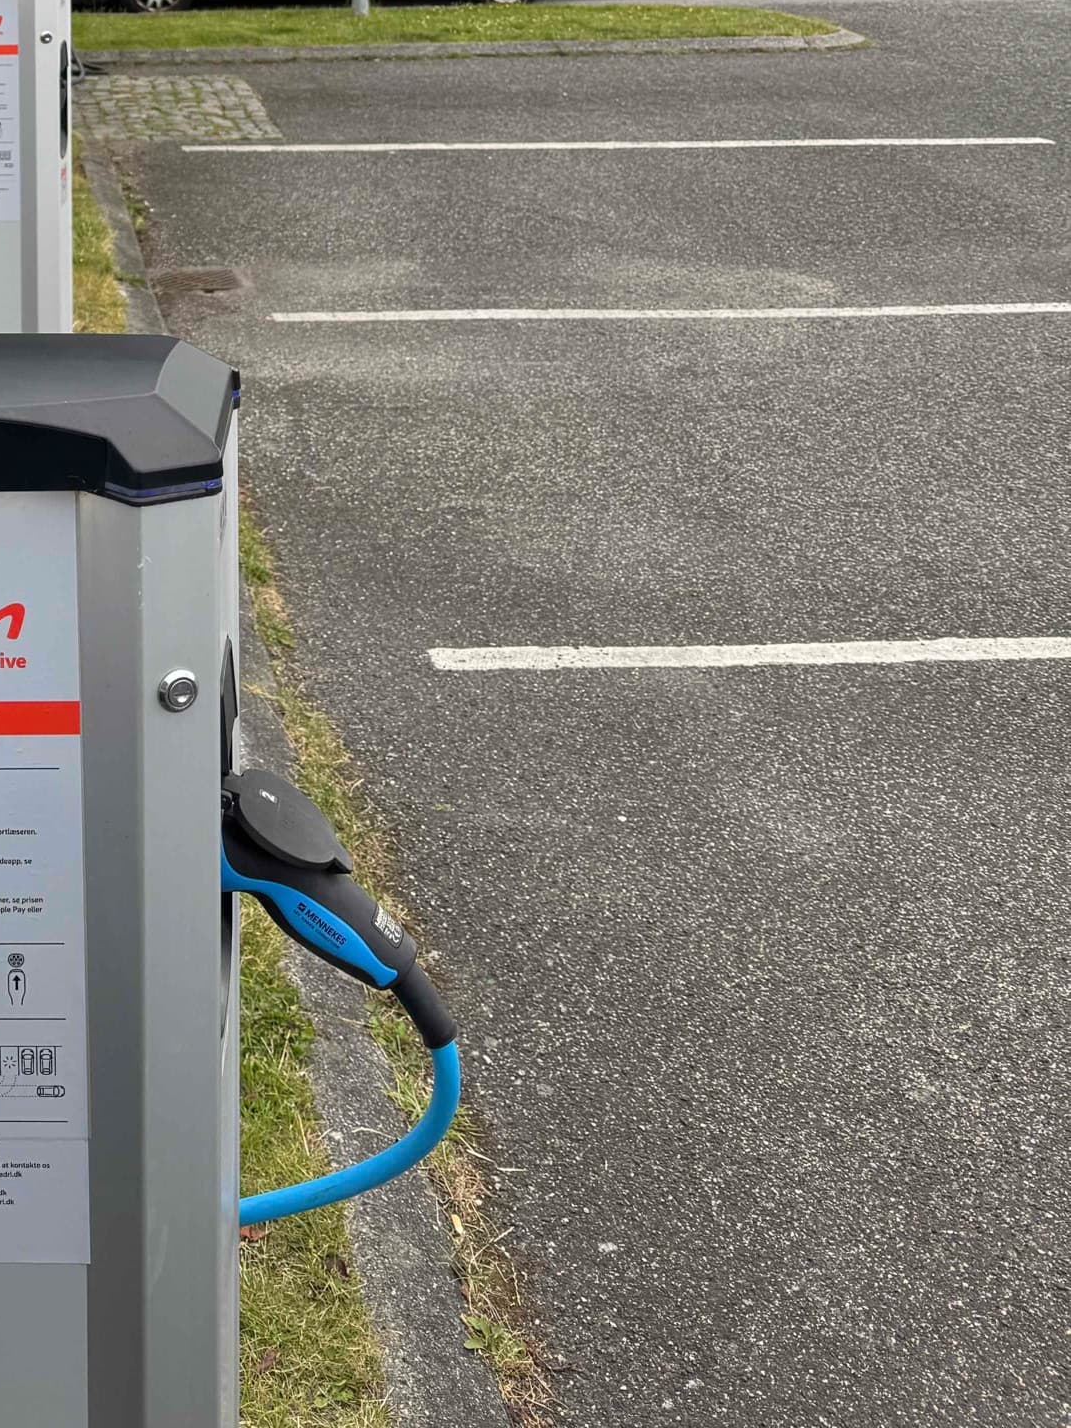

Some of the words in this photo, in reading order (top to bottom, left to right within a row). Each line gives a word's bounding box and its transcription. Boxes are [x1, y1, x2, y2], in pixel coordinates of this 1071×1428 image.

[21, 896, 44, 905] prisen
[12, 906, 26, 915] Pay
[304, 908, 347, 946] MENNEKES
